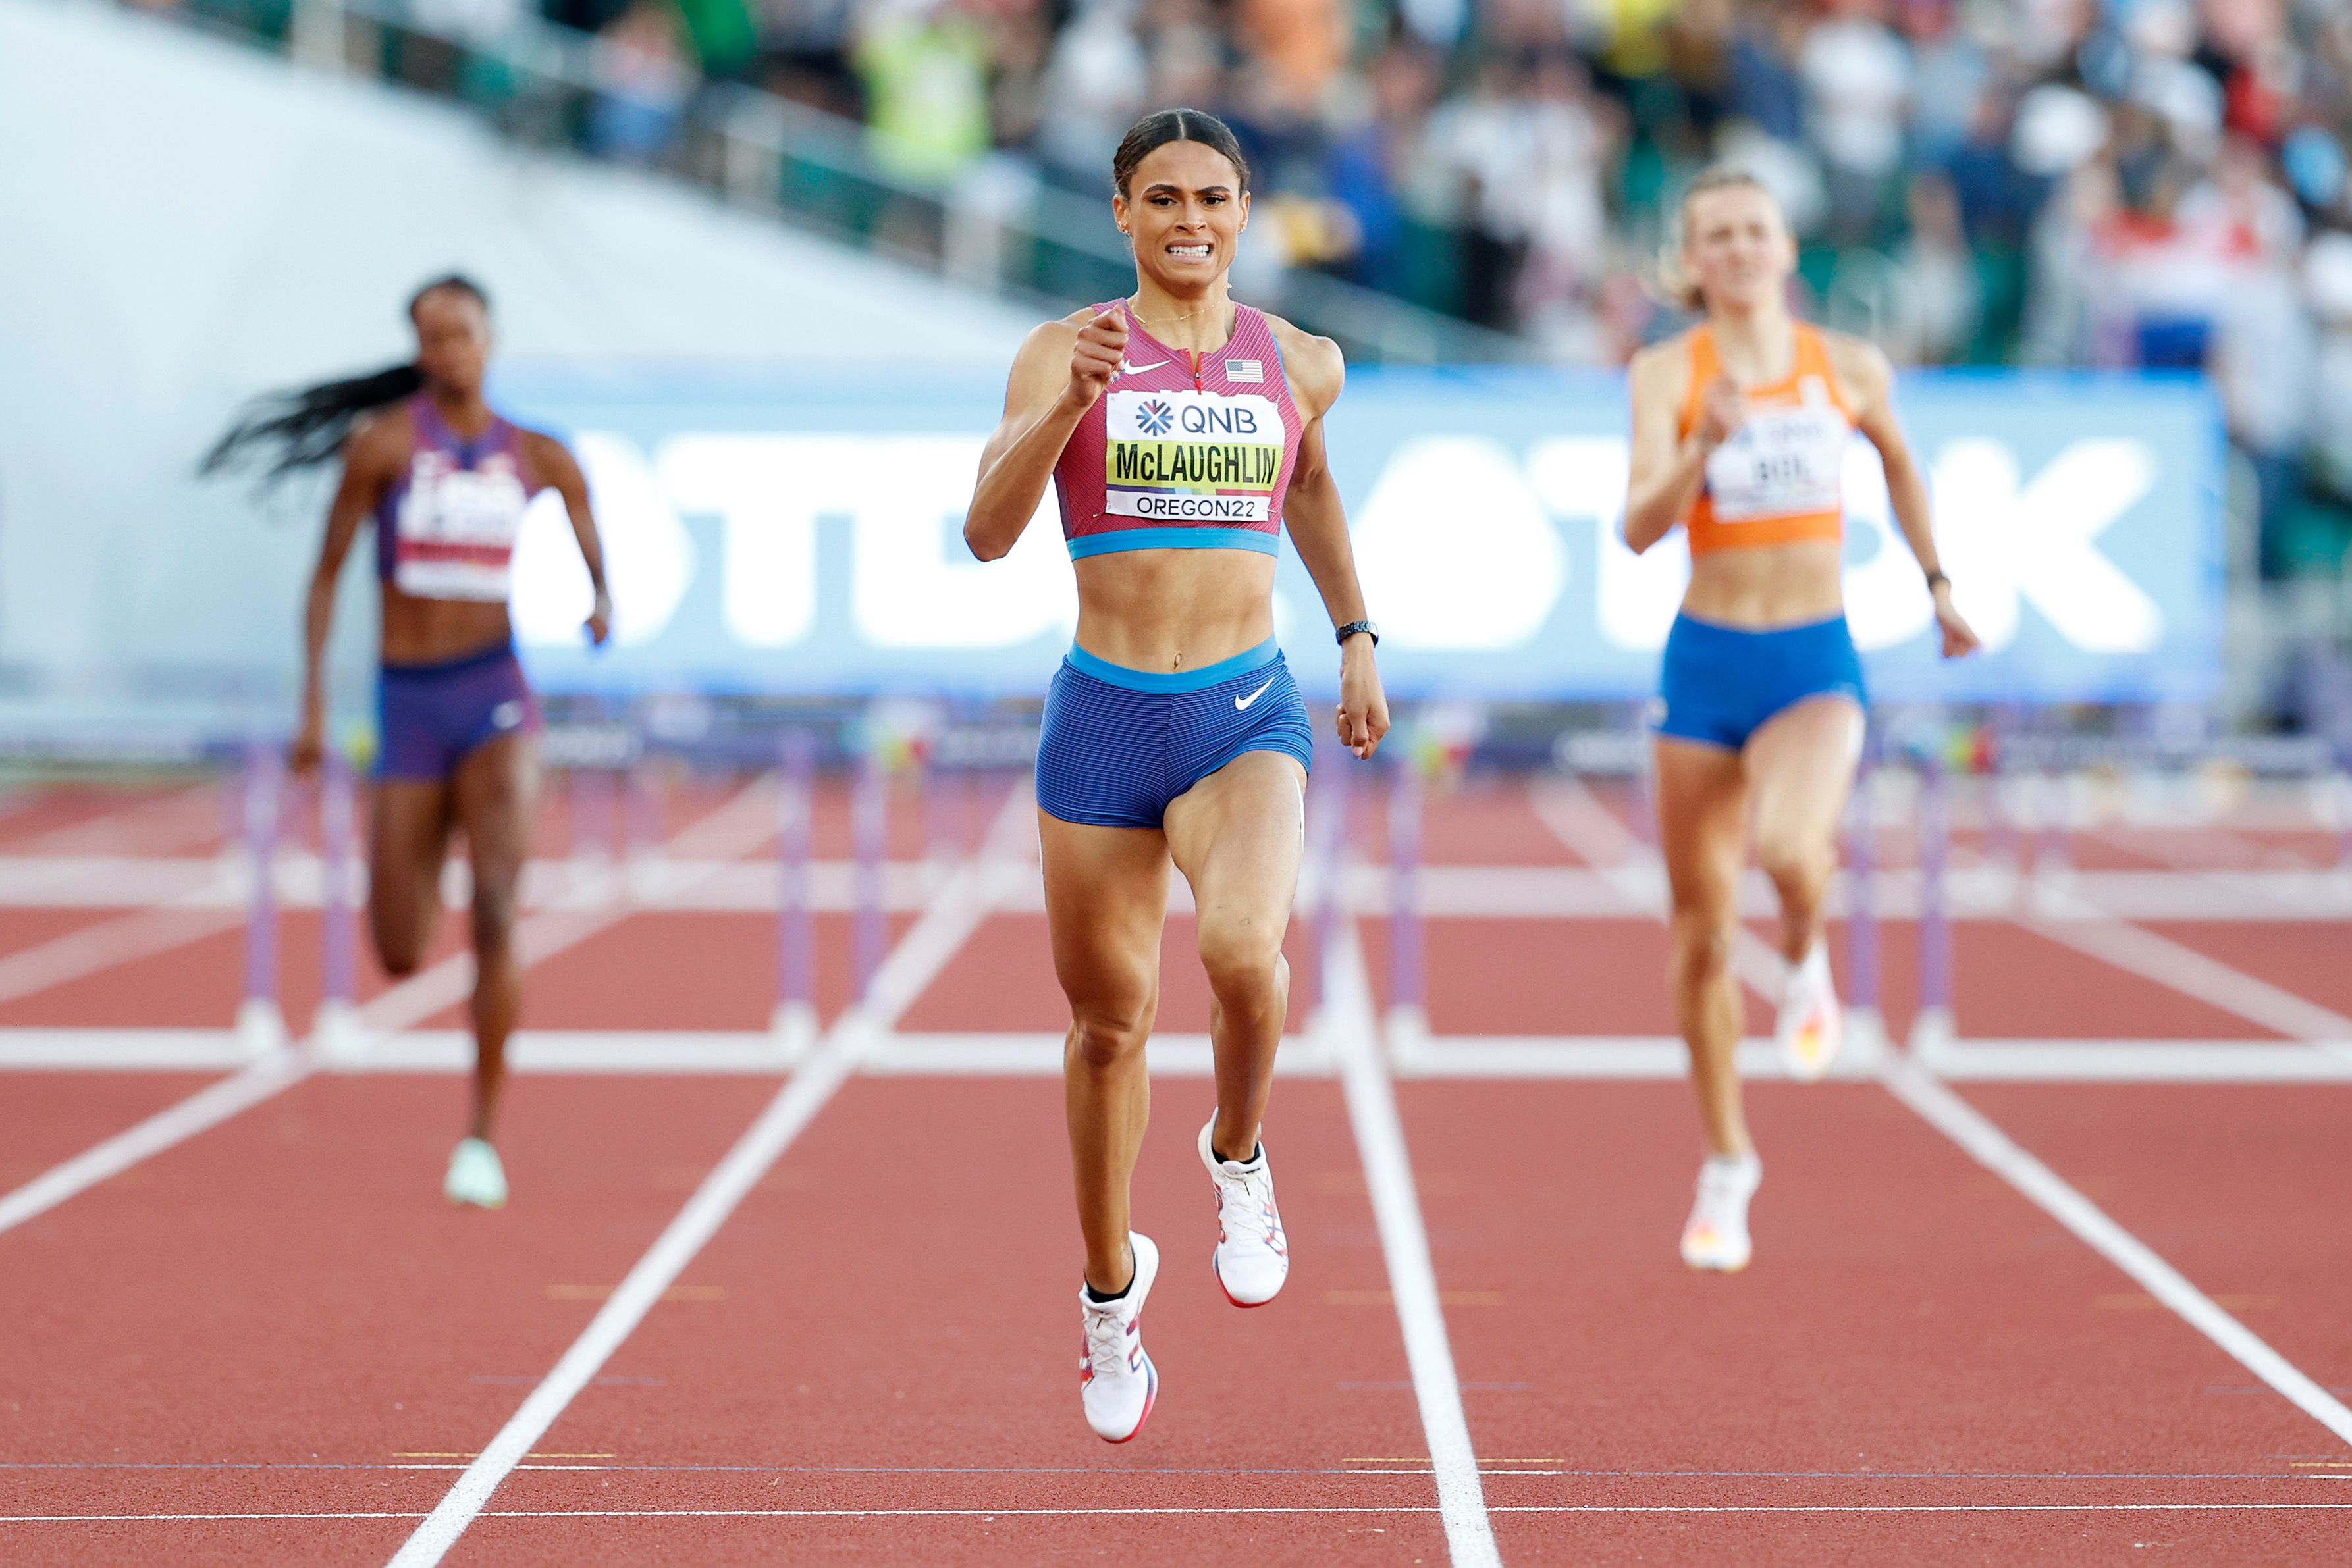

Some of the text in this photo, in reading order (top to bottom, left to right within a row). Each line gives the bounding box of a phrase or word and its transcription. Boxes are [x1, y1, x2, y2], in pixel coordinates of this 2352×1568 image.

[1181, 405, 1258, 434] QNB
[1116, 443, 1276, 484] McLAUGHLIN
[1136, 496, 1255, 518] OREGON22
